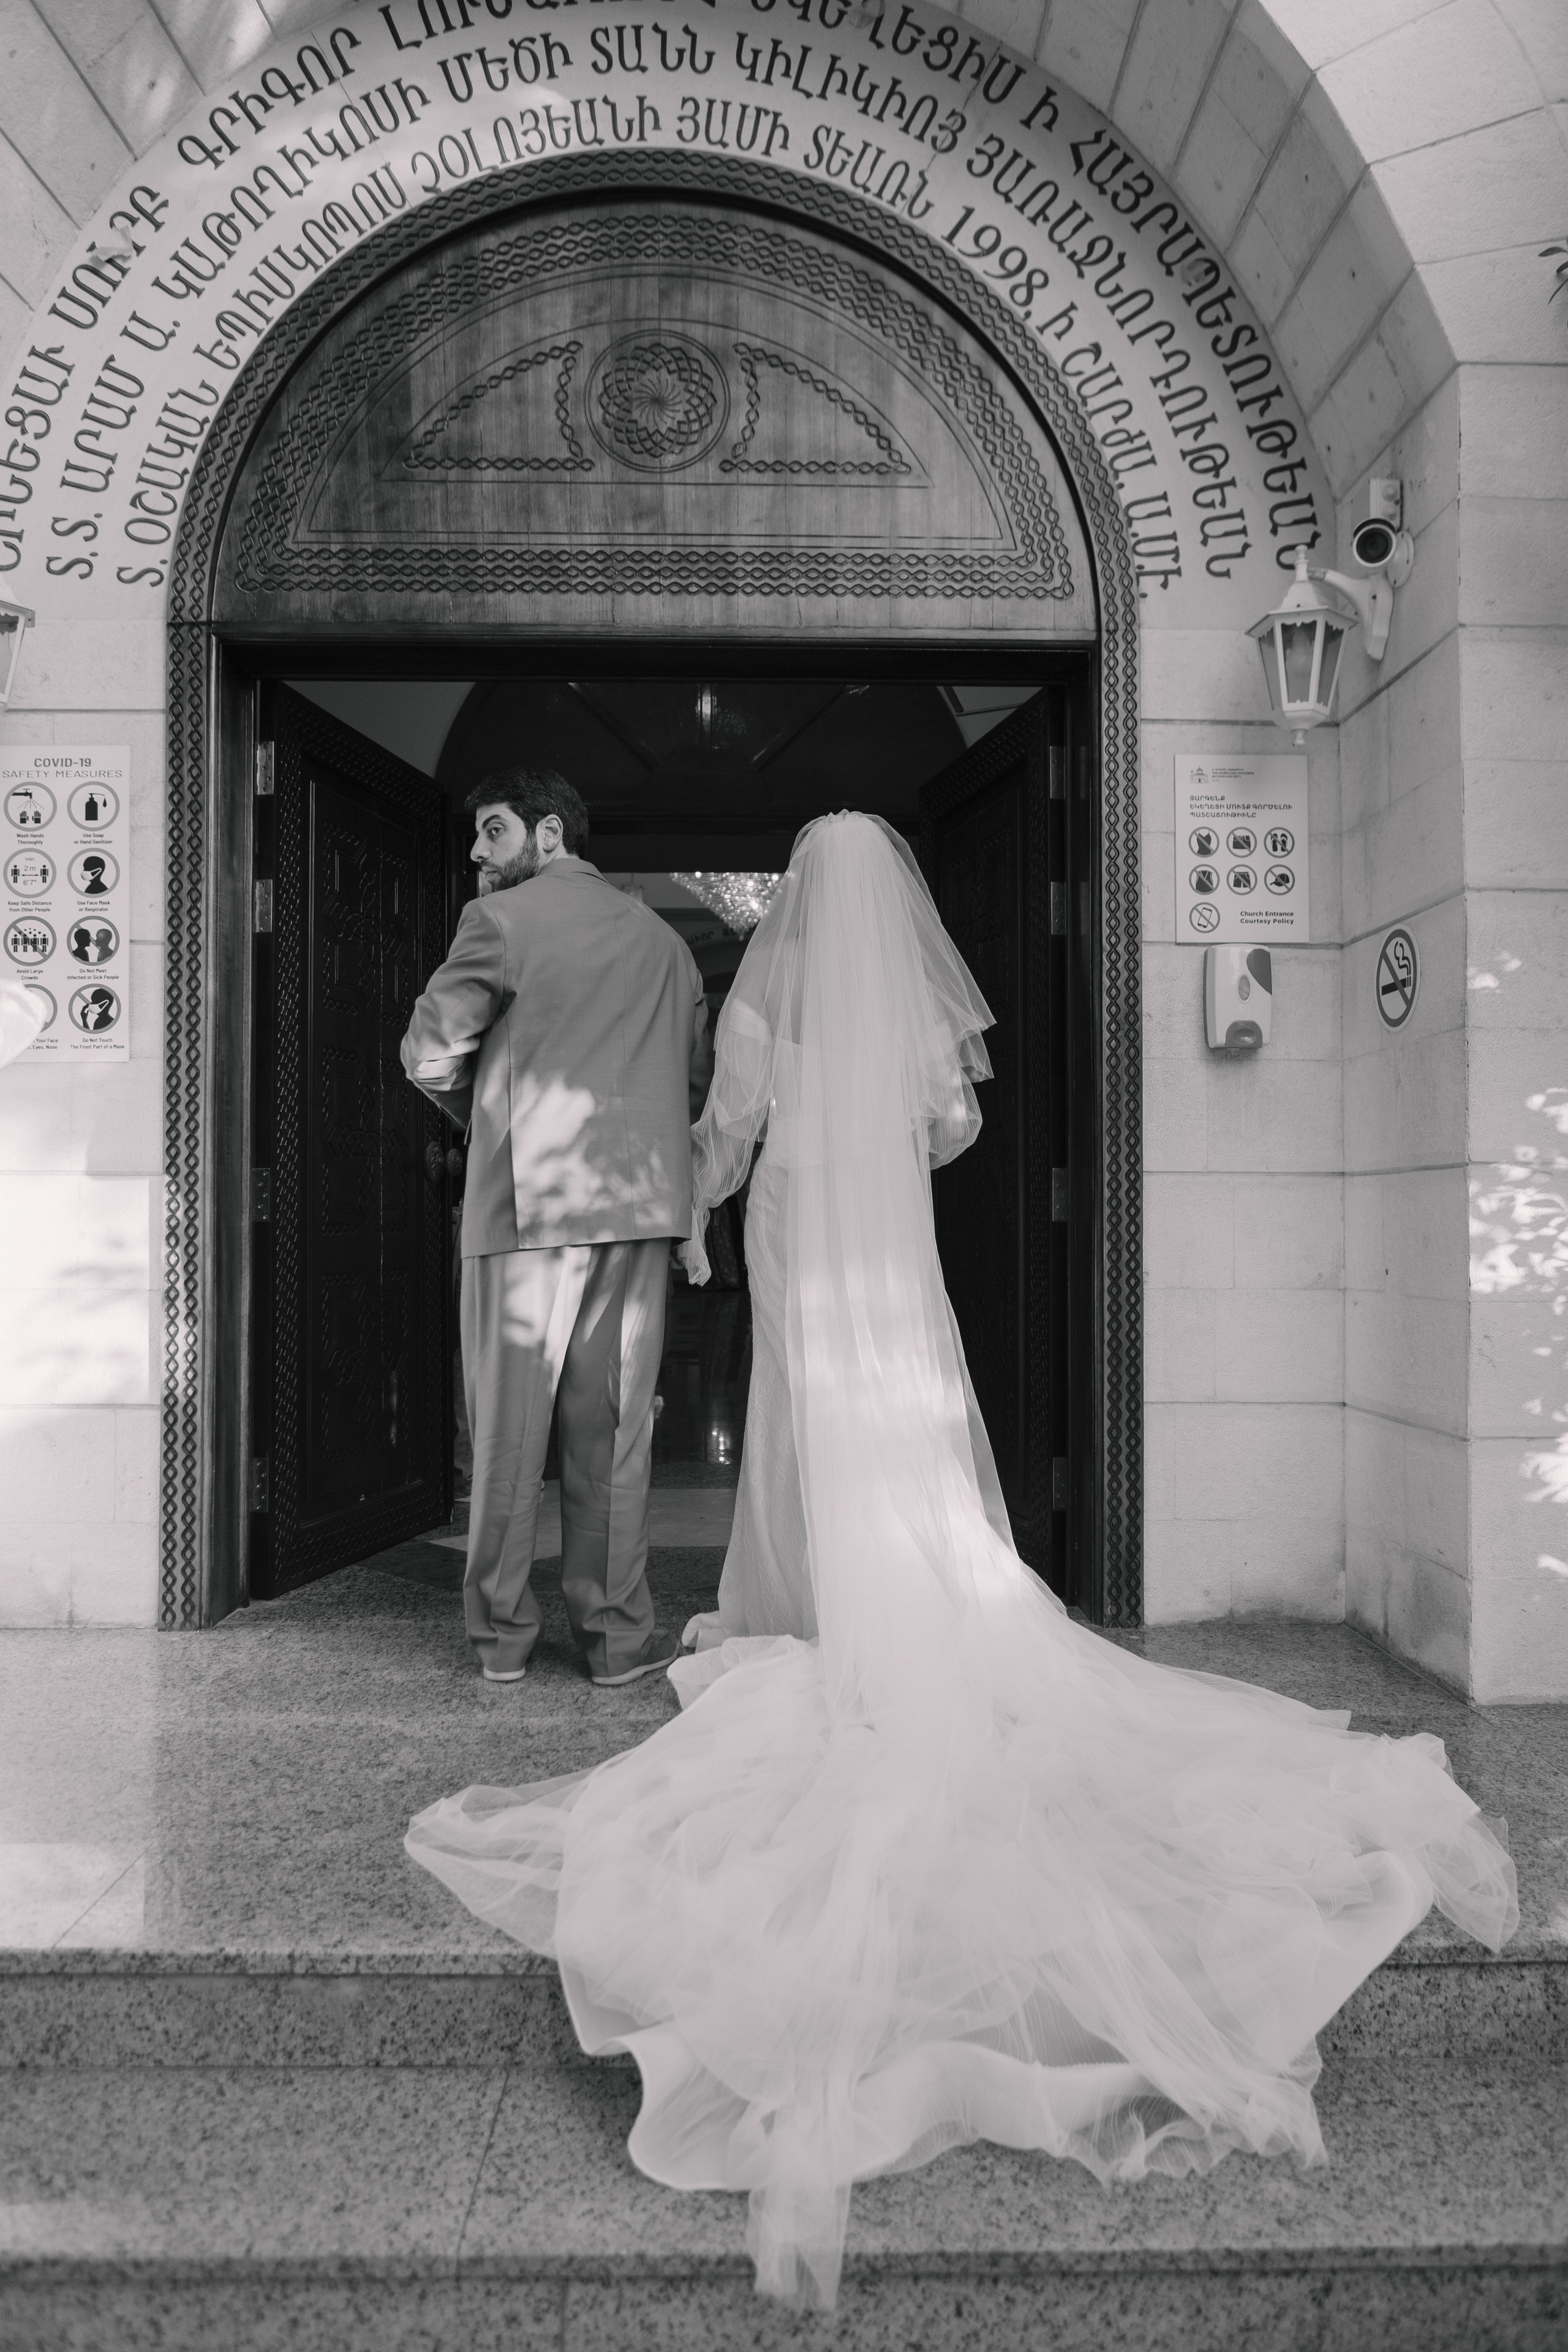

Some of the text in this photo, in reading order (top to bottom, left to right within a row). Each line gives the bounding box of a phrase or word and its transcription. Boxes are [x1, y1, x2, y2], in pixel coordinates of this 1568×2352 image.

[178, 28, 361, 170] ԳՐԻԳՈՐ
[1019, 85, 1058, 132] Ի
[412, 95, 662, 192] ՉՕԼՈՅԵԱՆԻ
[676, 96, 789, 156] ՅԱՄԻ
[804, 125, 934, 218] ՏԵԱՌՆ
[59, 354, 144, 492] ԱՐԱՄ
[119, 311, 180, 351] Ա.
[151, 78, 431, 299] ԿԱԹՈՂԻԿՈՍԻ
[437, 32, 573, 103] ՄԵԾԻ
[590, 22, 715, 75] ՏԱՆՆ
[736, 32, 967, 154] ԿԻԼԻԿԻՈՅ
[967, 134, 1252, 579] ՅԱՌԱՋՆՈՐԴՈՒԹԵԱՆ
[193, 162, 406, 369] ԵՊԻՍԿՈՊՈՍ
[1036, 301, 1078, 341] Ի
[124, 380, 219, 545] ՕՇԱԿԱՆ
[1062, 342, 1157, 489] ՇԱՐԺԱ.
[116, 560, 167, 587] Տ.
[34, 758, 91, 767] COVID-19
